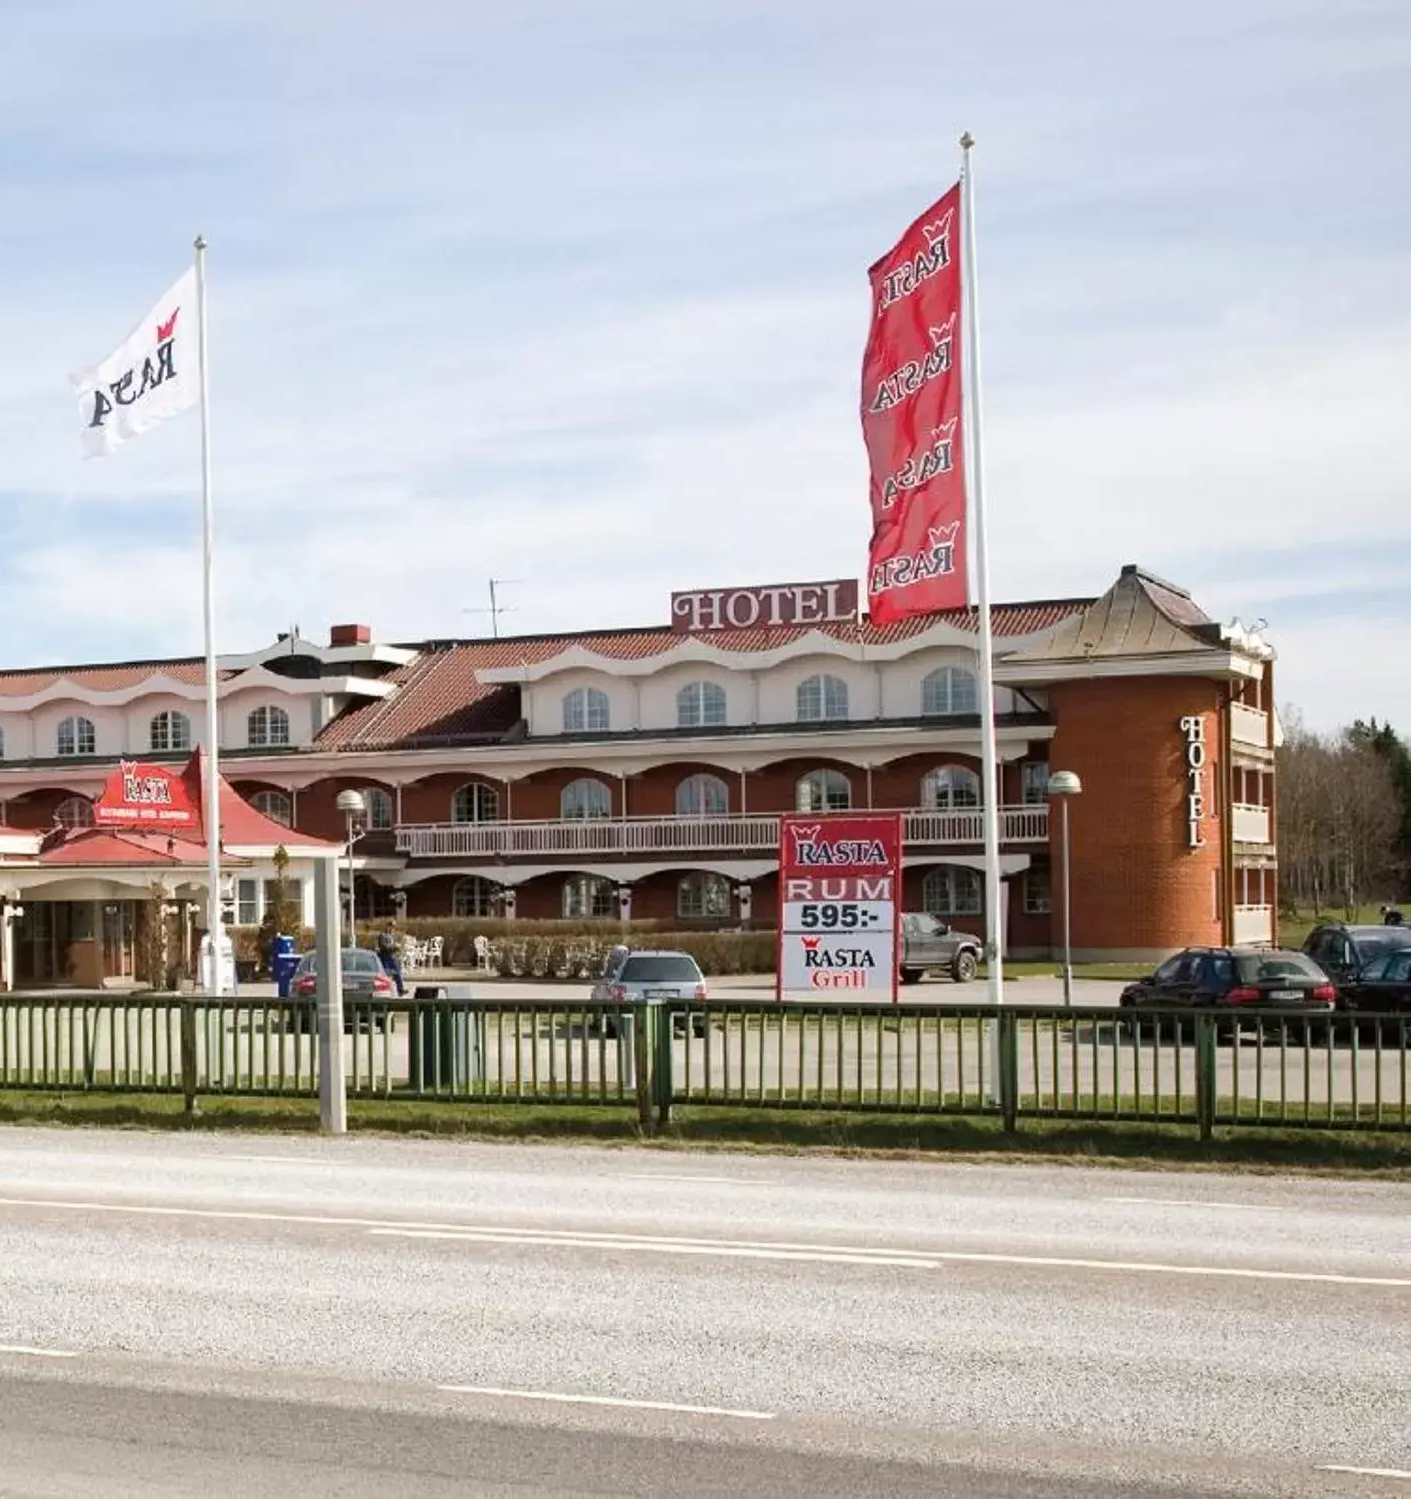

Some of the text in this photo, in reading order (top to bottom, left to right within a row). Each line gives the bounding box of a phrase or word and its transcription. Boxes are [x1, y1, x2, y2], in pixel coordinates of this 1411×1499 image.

[673, 584, 857, 630] HOTEL
[1180, 716, 1206, 846] HOTEL
[796, 840, 888, 866] RASTA
[789, 879, 891, 900] RUM
[800, 904, 879, 928] 595:-
[804, 949, 875, 968] RASTA
[812, 970, 867, 991] Grill
